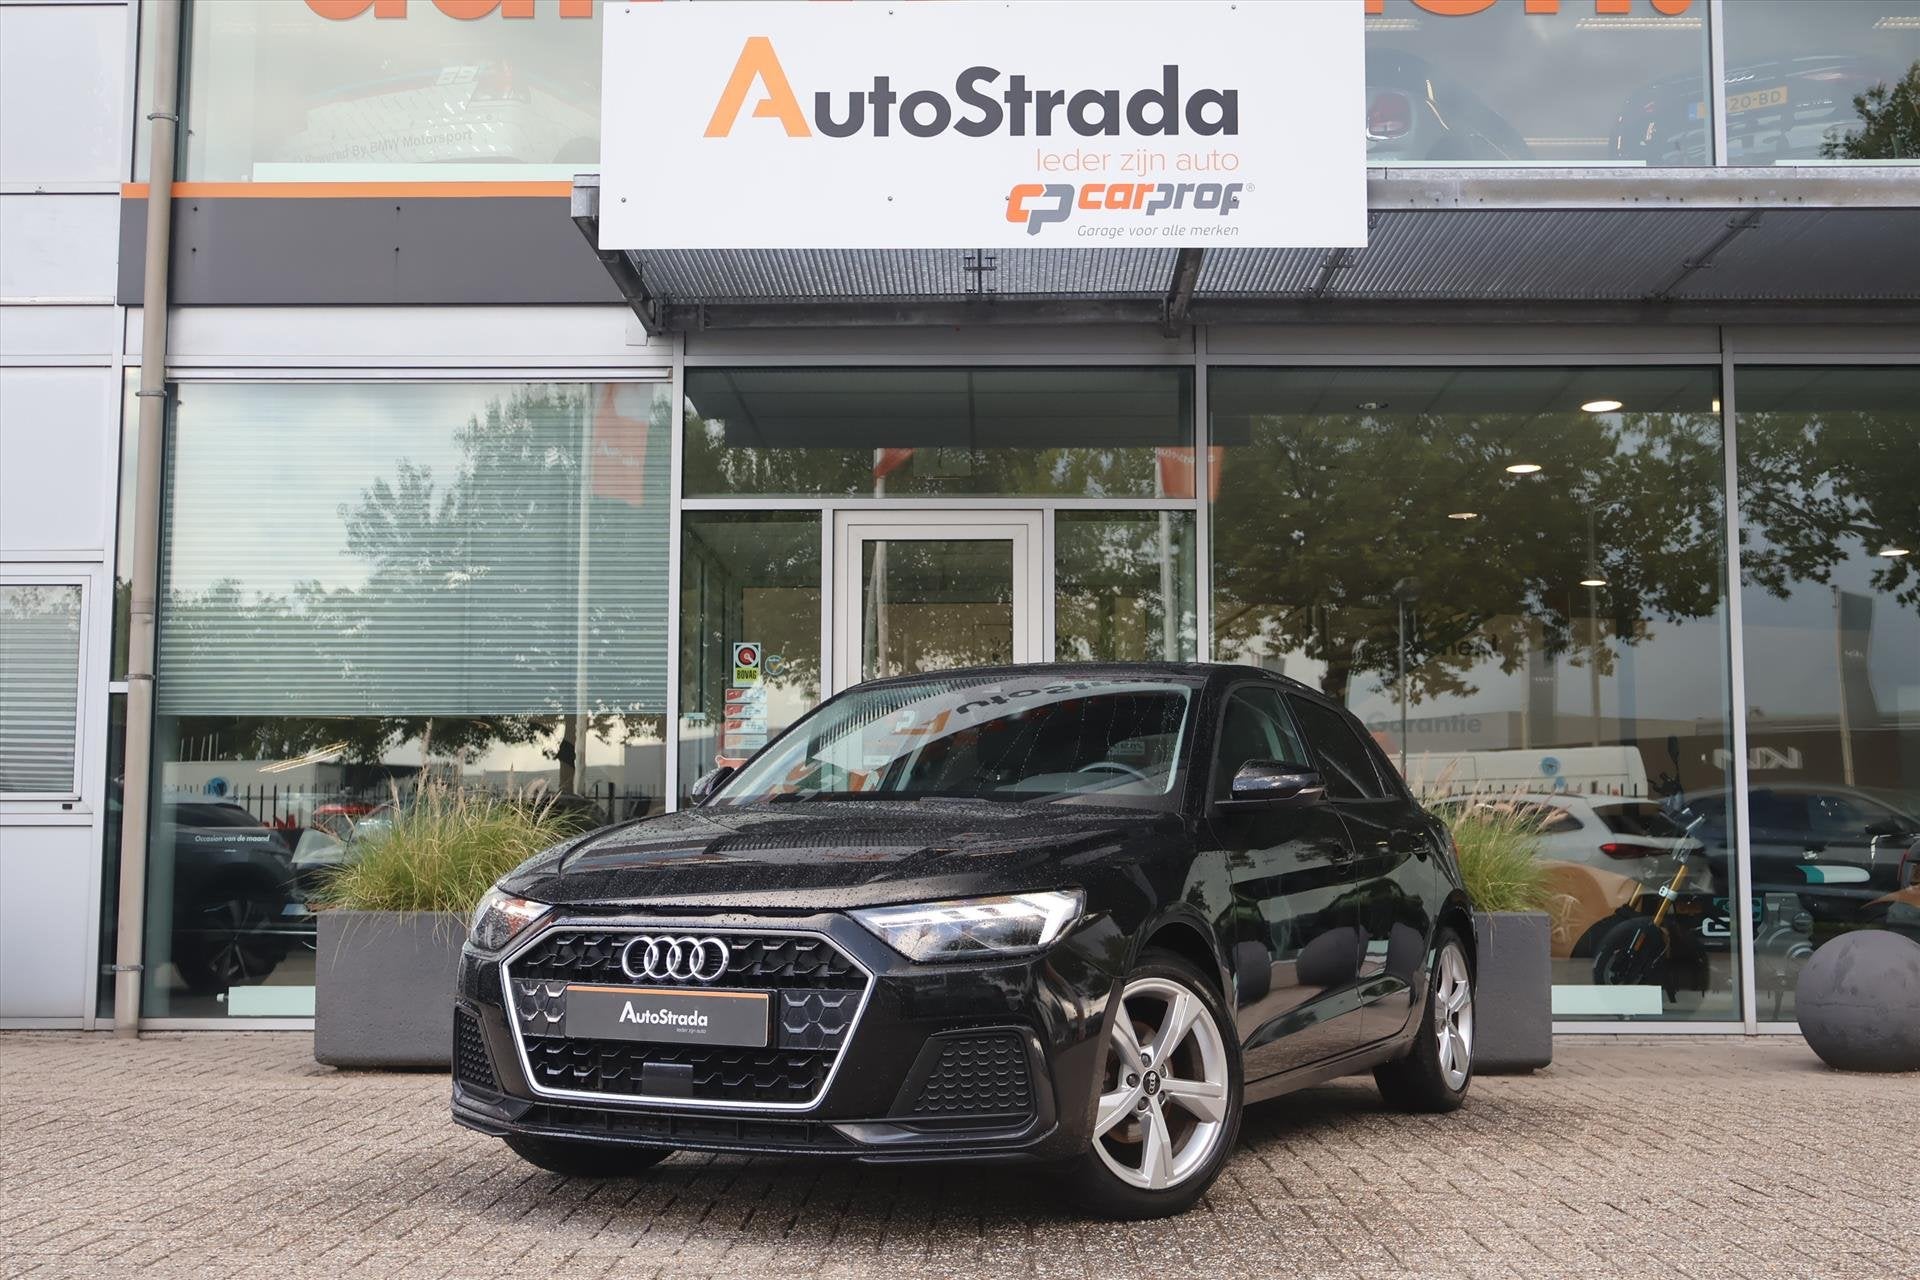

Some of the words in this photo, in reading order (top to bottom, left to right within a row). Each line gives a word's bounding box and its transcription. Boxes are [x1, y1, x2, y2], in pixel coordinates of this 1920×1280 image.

[702, 36, 1239, 138] AutoStrada
[400, 129, 473, 149] Motorsport
[1036, 148, 1111, 172] Ieder
[1120, 148, 1166, 177] zijn
[1176, 150, 1239, 172] auto
[1077, 224, 1124, 239] Garage
[1129, 225, 1158, 236] voor
[1162, 224, 1186, 236] alle
[1190, 224, 1239, 236] merken
[736, 669, 757, 680] BOVAG
[194, 834, 223, 842] Occasion
[237, 833, 246, 842] de
[246, 833, 271, 842] maand
[619, 1000, 708, 1027] AutoStrada
